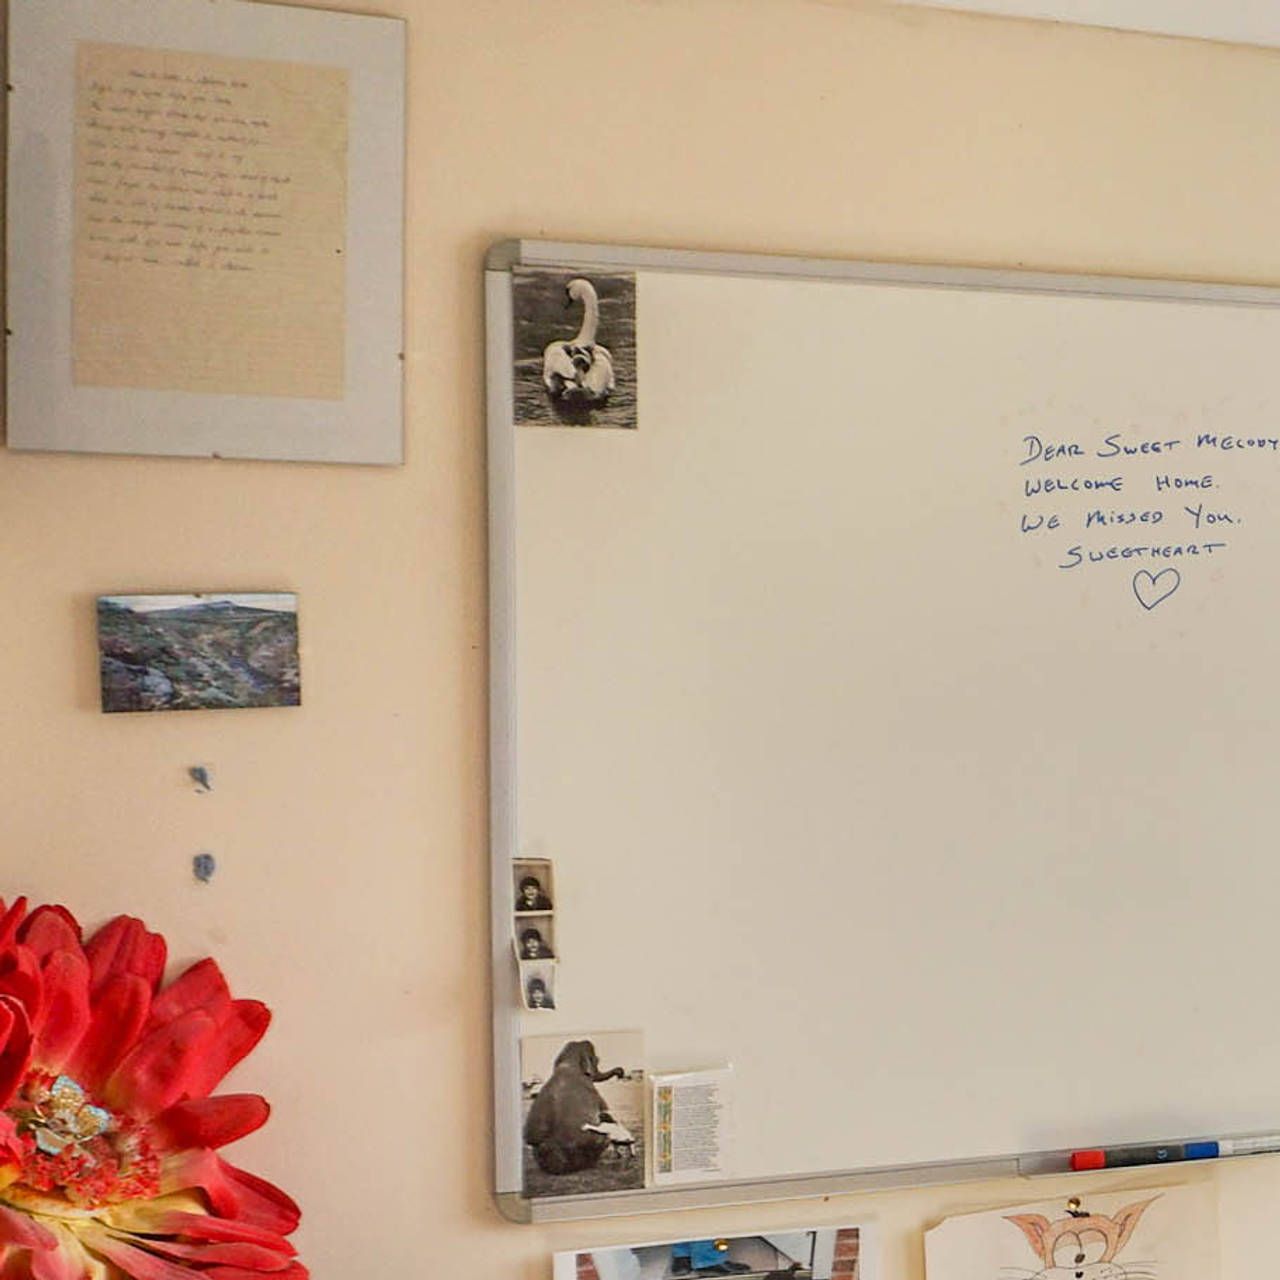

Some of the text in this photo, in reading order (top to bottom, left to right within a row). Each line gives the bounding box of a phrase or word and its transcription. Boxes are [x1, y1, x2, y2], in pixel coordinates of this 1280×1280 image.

[1019, 435, 1084, 465] DEAR
[1097, 434, 1181, 457] SWEET
[1025, 477, 1124, 497] WELCOME
[1020, 513, 1060, 532] WE
[1058, 542, 1227, 568] SWEETHEART
